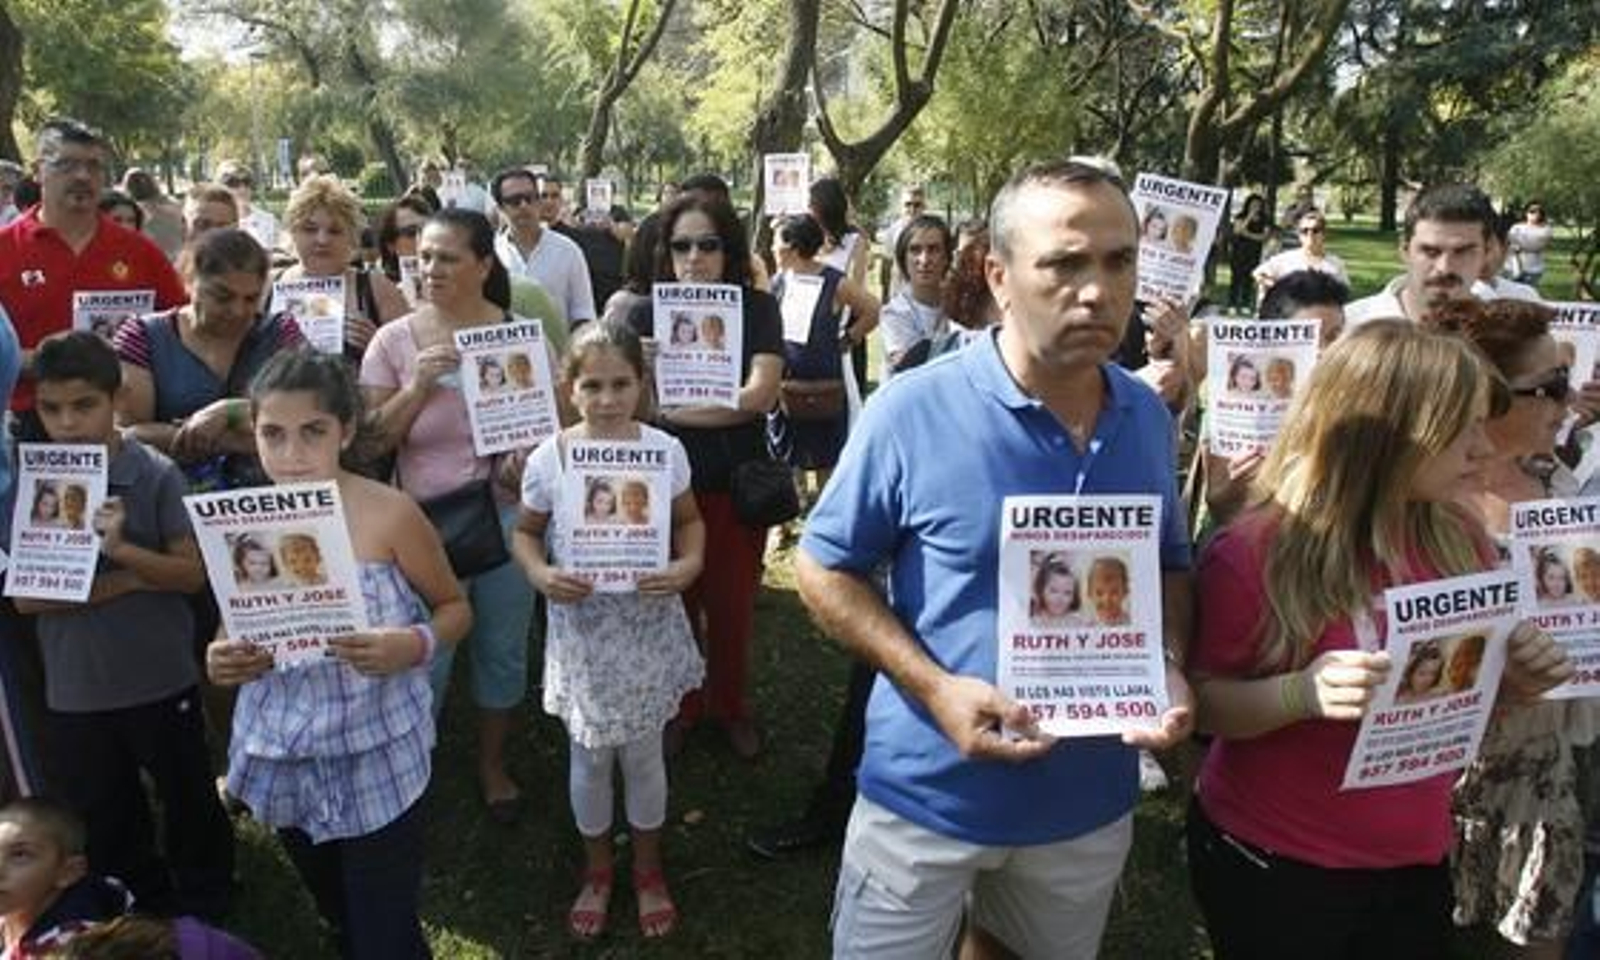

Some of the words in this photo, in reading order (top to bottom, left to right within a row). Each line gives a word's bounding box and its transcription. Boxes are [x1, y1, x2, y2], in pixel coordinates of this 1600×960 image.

[1140, 178, 1224, 207] URGENTE
[78, 294, 151, 307] URGENTE
[658, 286, 740, 302] URGENTE
[459, 324, 541, 346] URGENTE
[1213, 325, 1315, 340] URGENTE
[24, 451, 103, 468] URGENTE
[572, 448, 667, 463] URGENTE
[194, 489, 334, 518] URGENTE
[1012, 506, 1154, 529] URGENTE
[1515, 504, 1600, 528] URGENT
[229, 595, 279, 609] RUTH
[283, 593, 294, 603] Y
[301, 587, 347, 603] JOSE
[1395, 581, 1519, 623] URGENTE
[1576, 611, 1585, 625] Y
[287, 637, 320, 651] 594
[1012, 634, 1070, 649] RUTH
[1077, 634, 1089, 648] Y
[1096, 633, 1147, 649] JOSE
[1053, 686, 1074, 698] HAS
[1079, 685, 1111, 698] VISTO
[1023, 704, 1057, 720] 57
[1066, 704, 1108, 720] 594
[1115, 702, 1157, 717] 500
[1373, 707, 1425, 726] RUTH
[1429, 704, 1440, 717] Y
[1442, 690, 1483, 714] JOSE
[1359, 763, 1393, 780] 957
[1396, 755, 1431, 774] 594
[1433, 747, 1466, 767] 500
